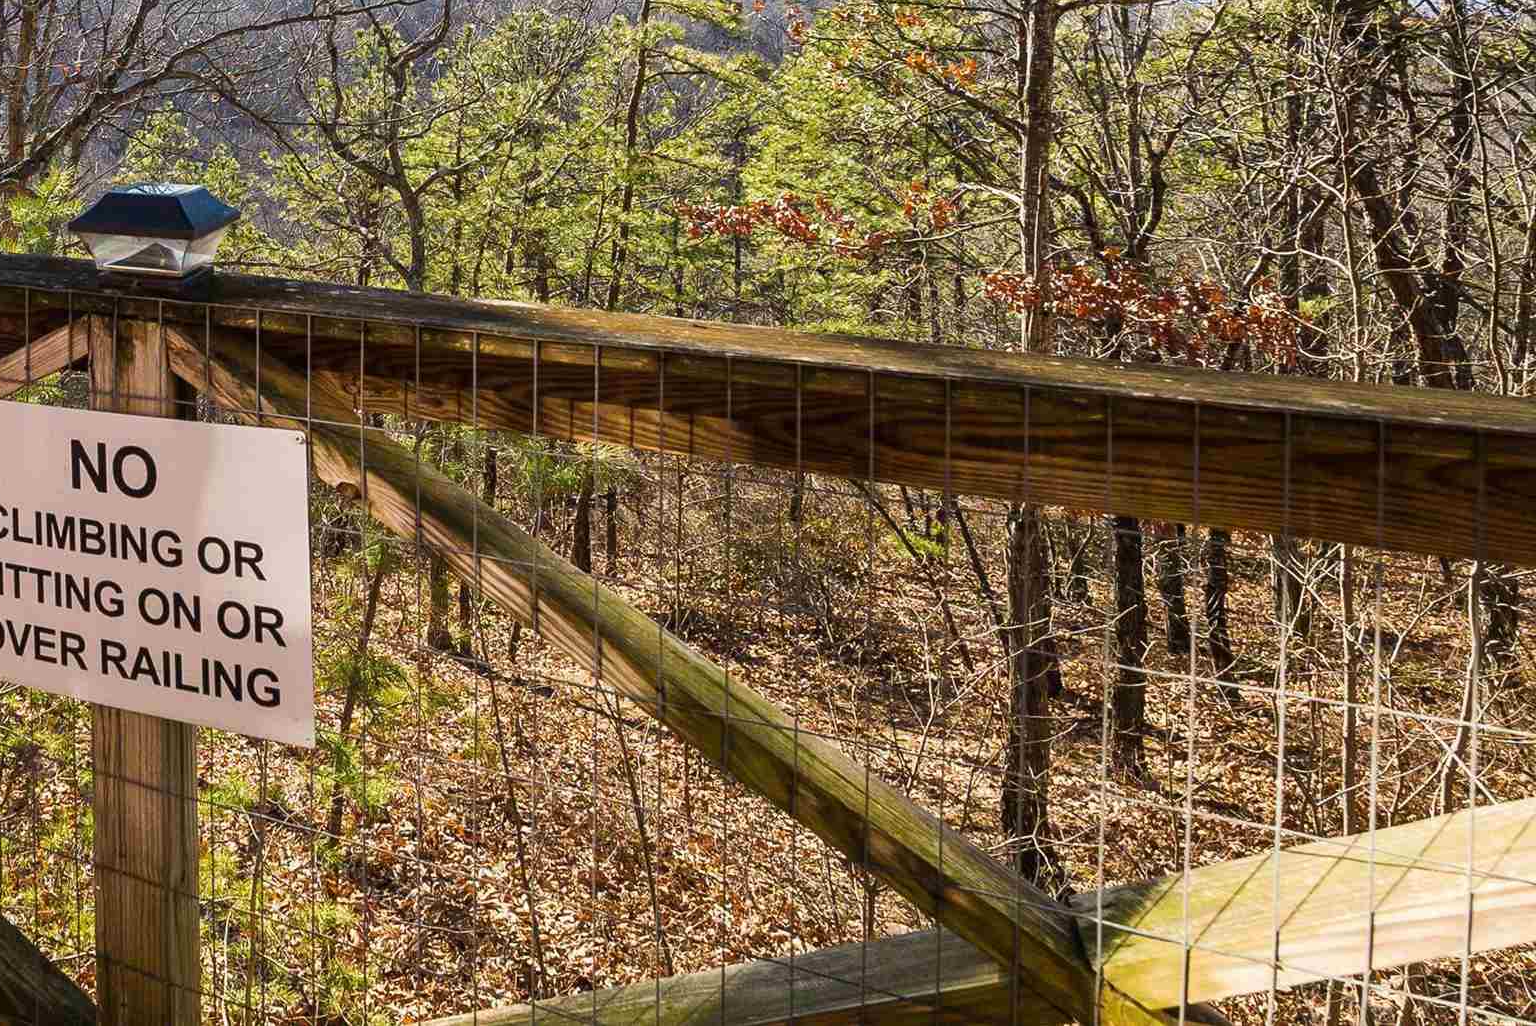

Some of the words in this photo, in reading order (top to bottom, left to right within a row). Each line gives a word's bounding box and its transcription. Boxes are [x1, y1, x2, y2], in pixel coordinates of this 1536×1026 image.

[70, 439, 158, 499] NO
[197, 536, 267, 581] OR
[137, 587, 202, 634] ON
[216, 600, 287, 648] OR
[100, 638, 281, 708] RAILING
